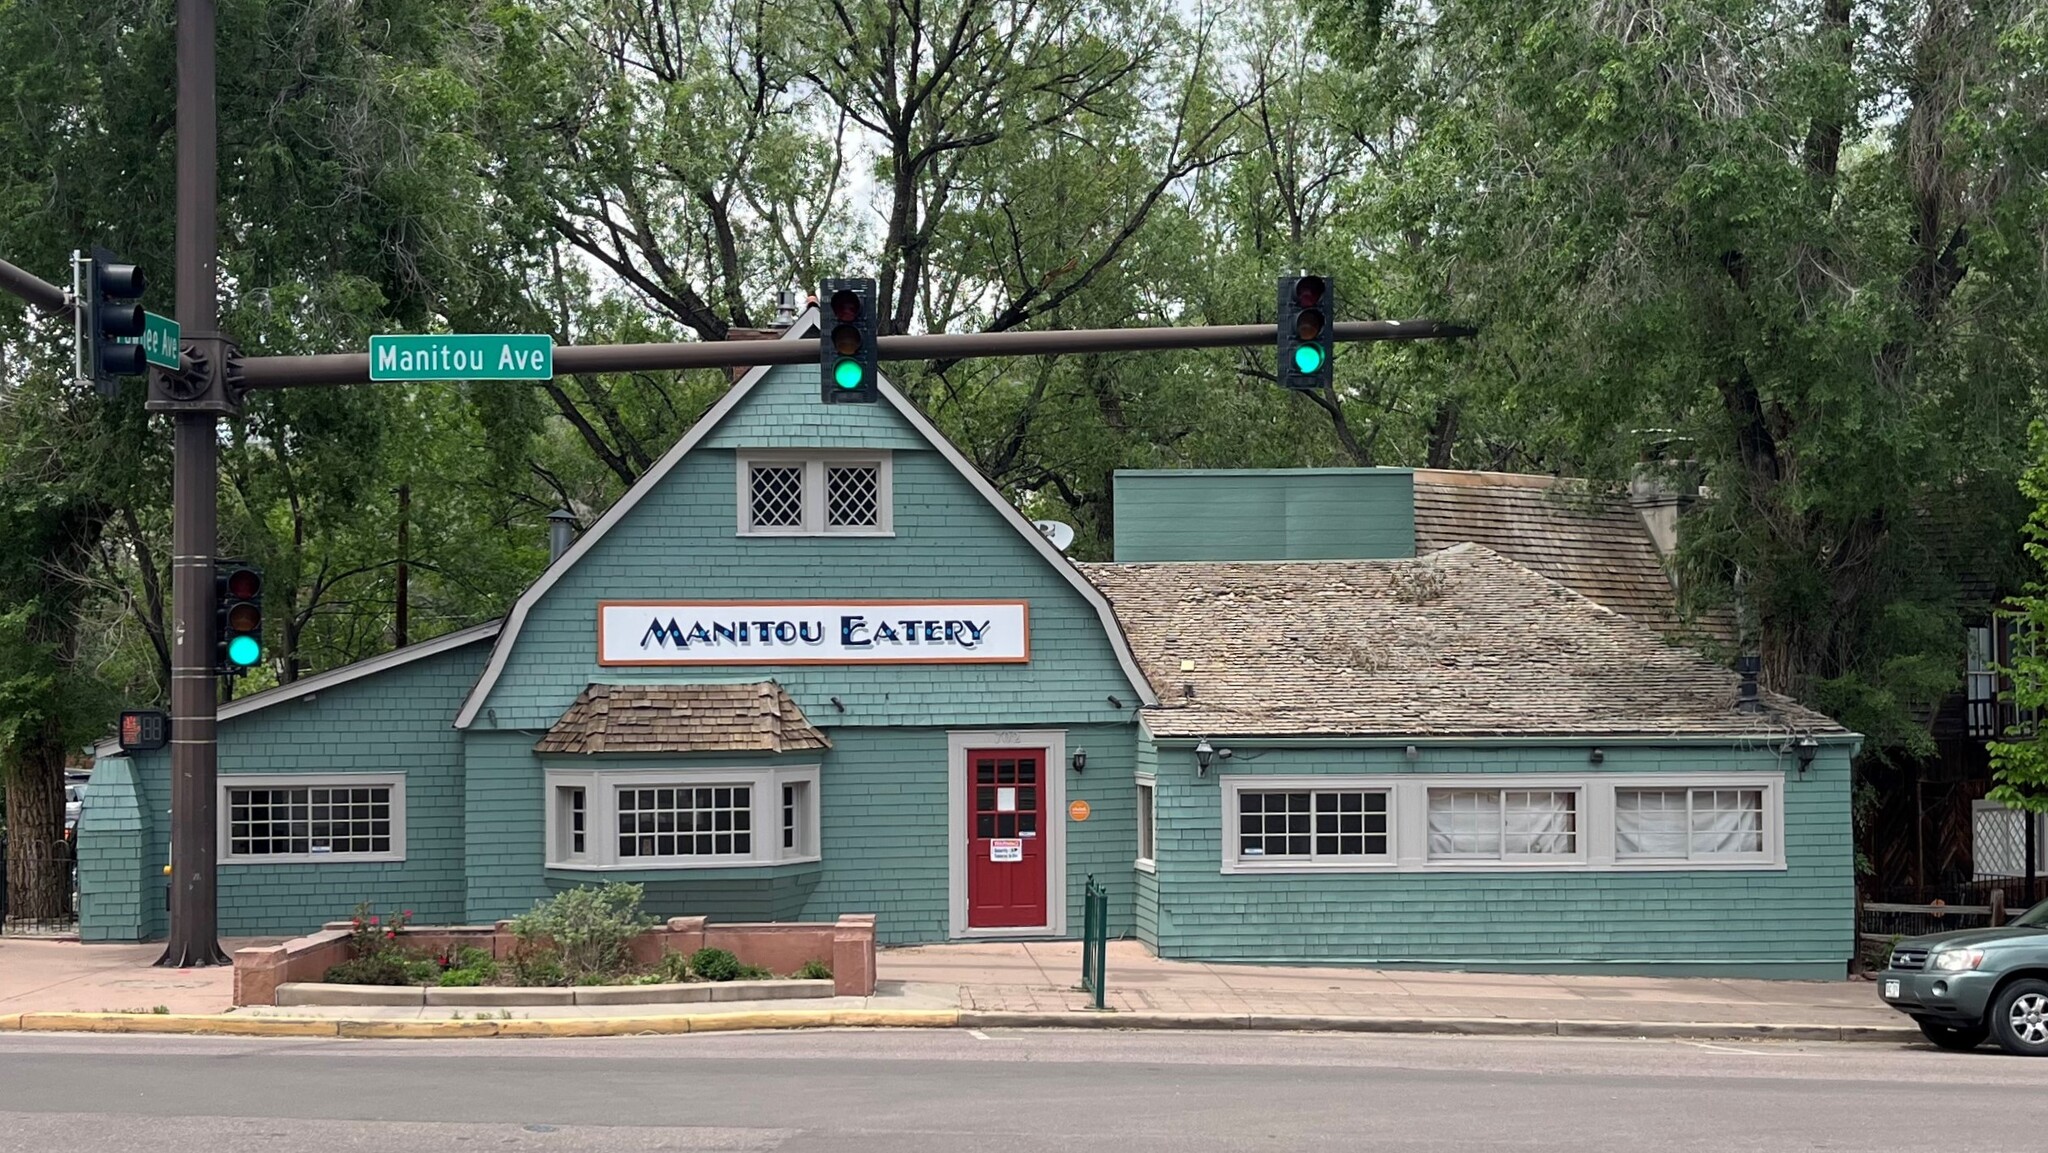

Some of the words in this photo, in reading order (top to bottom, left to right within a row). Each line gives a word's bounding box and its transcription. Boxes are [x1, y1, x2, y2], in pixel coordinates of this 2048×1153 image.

[161, 327, 177, 360] Ave
[378, 344, 484, 372] Manitou
[498, 344, 544, 371] Ave
[640, 616, 824, 648] MANITOU
[840, 615, 990, 648] EATERY
